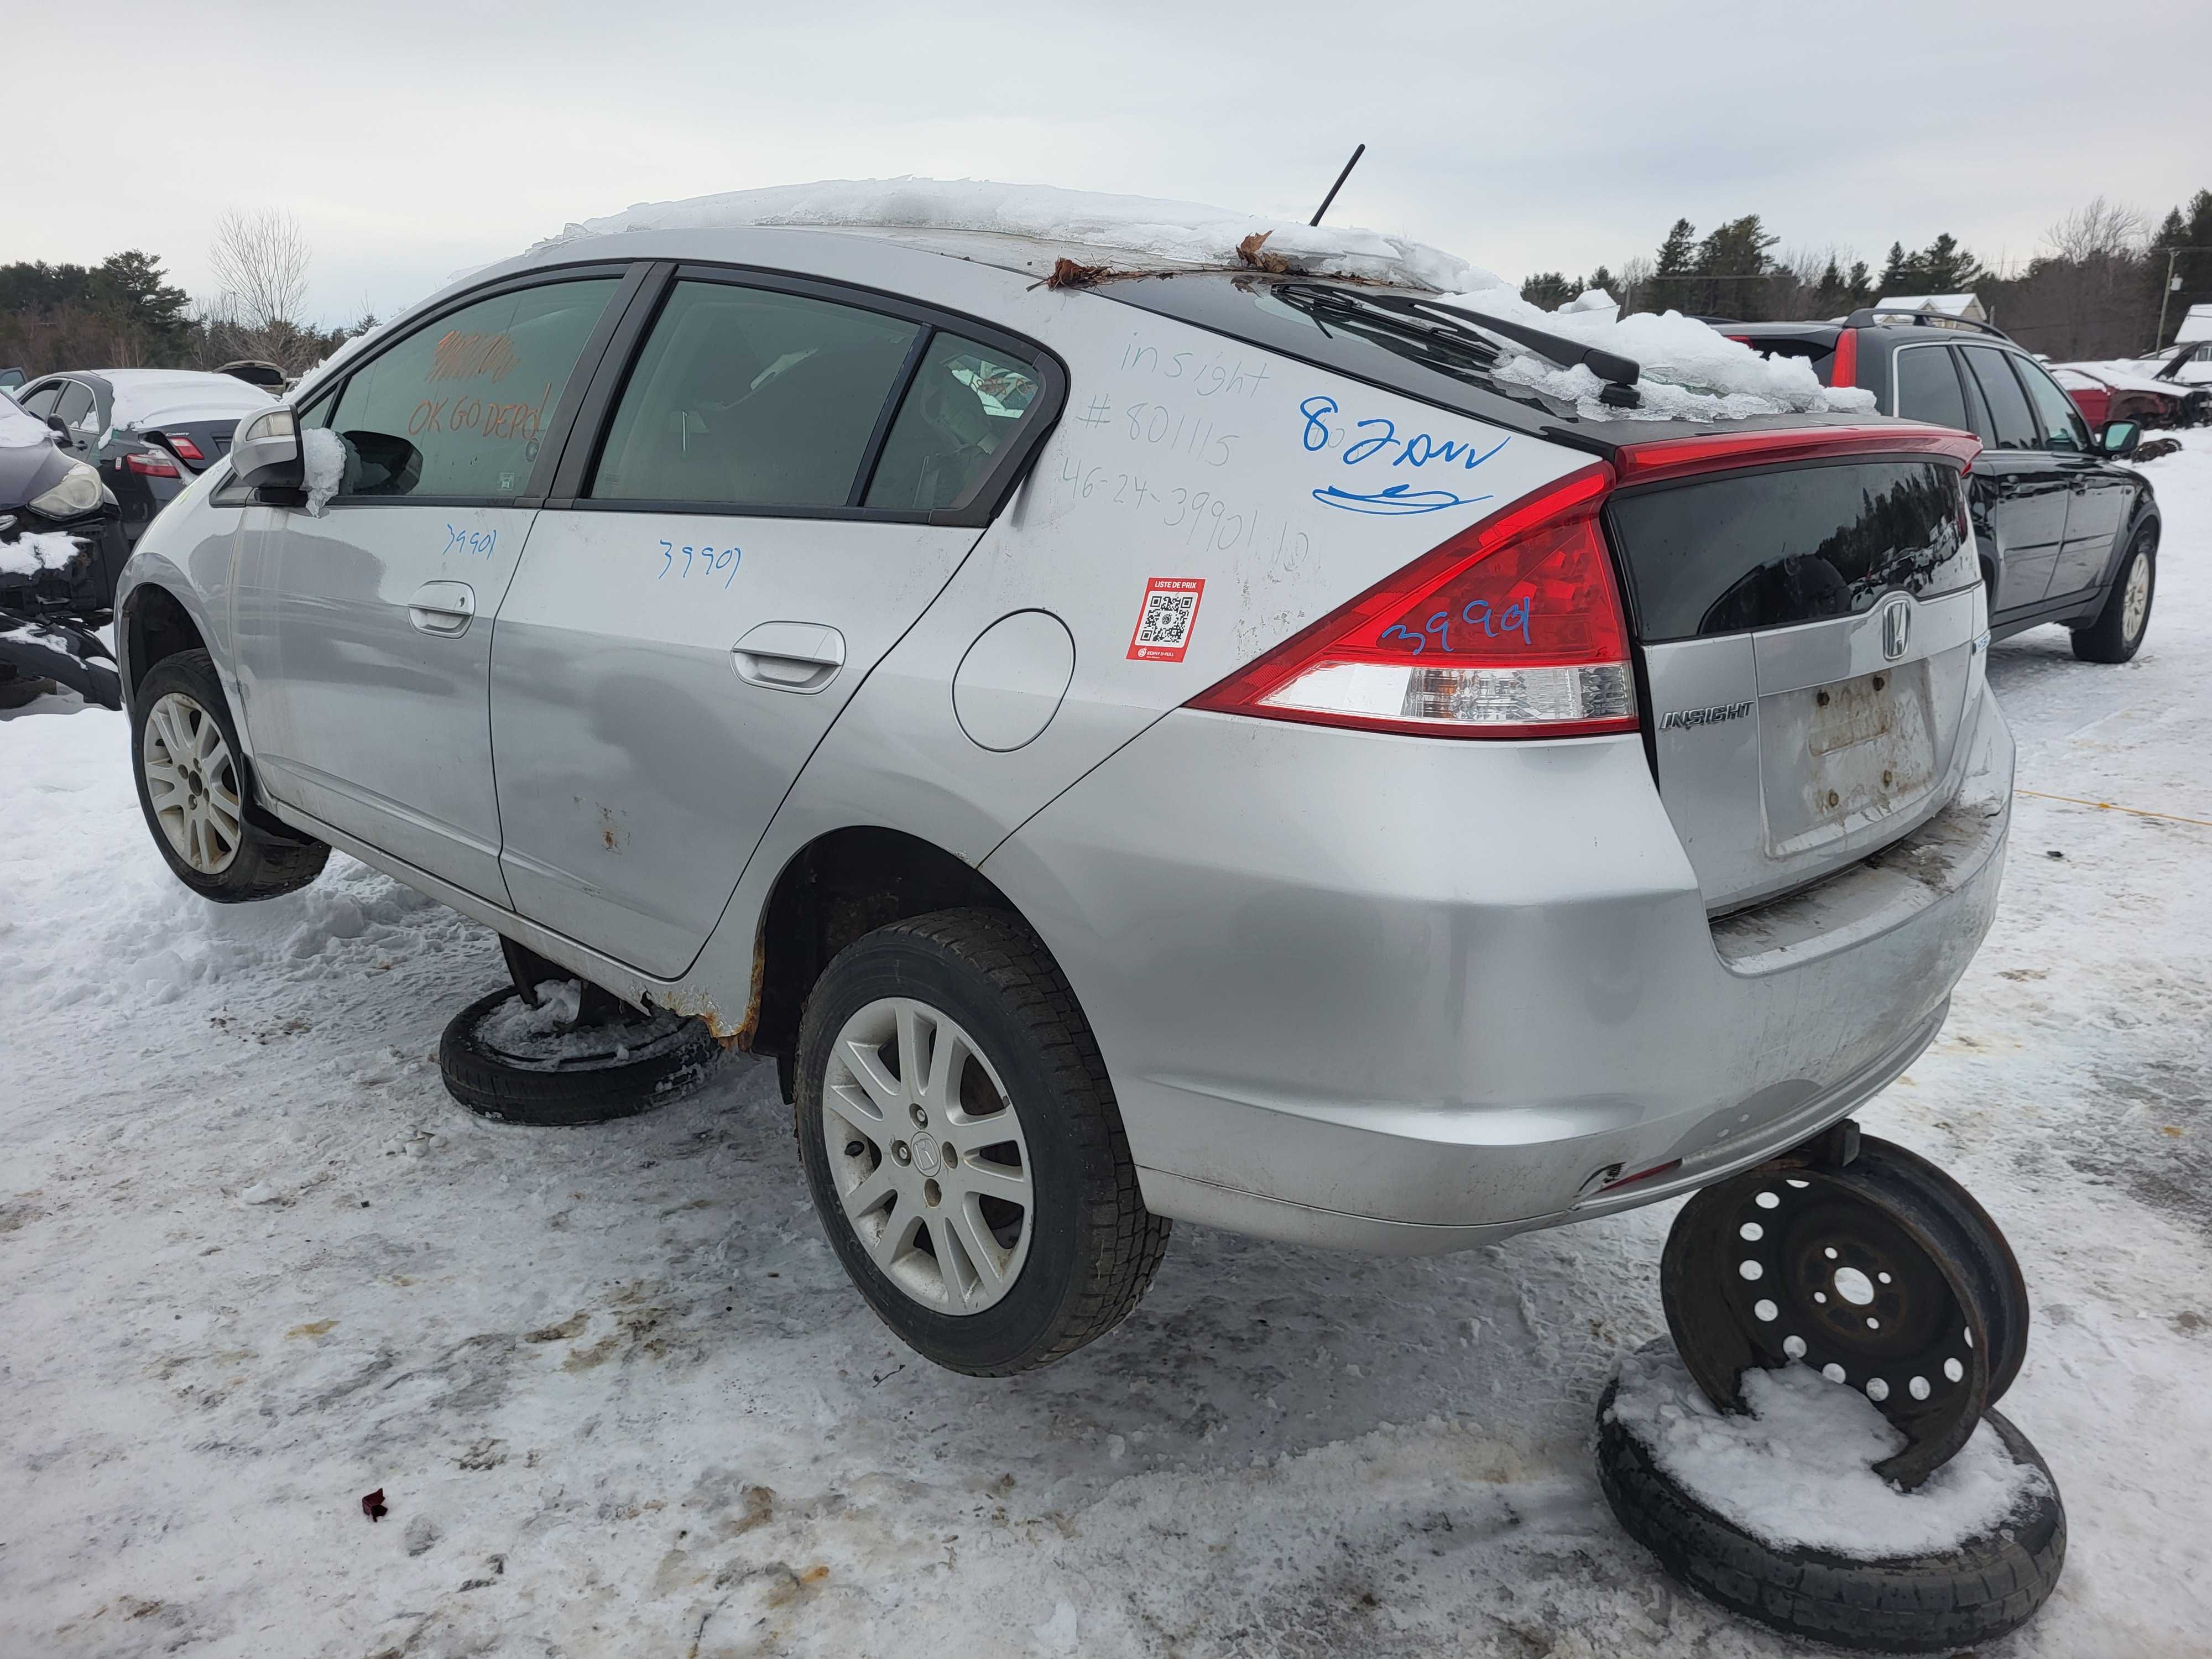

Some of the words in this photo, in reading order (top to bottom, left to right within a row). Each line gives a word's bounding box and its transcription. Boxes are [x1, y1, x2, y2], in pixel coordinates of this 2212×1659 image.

[408, 397, 449, 436] OK
[658, 539, 742, 590] 39901
[1658, 700, 1756, 731] INSIGHT
